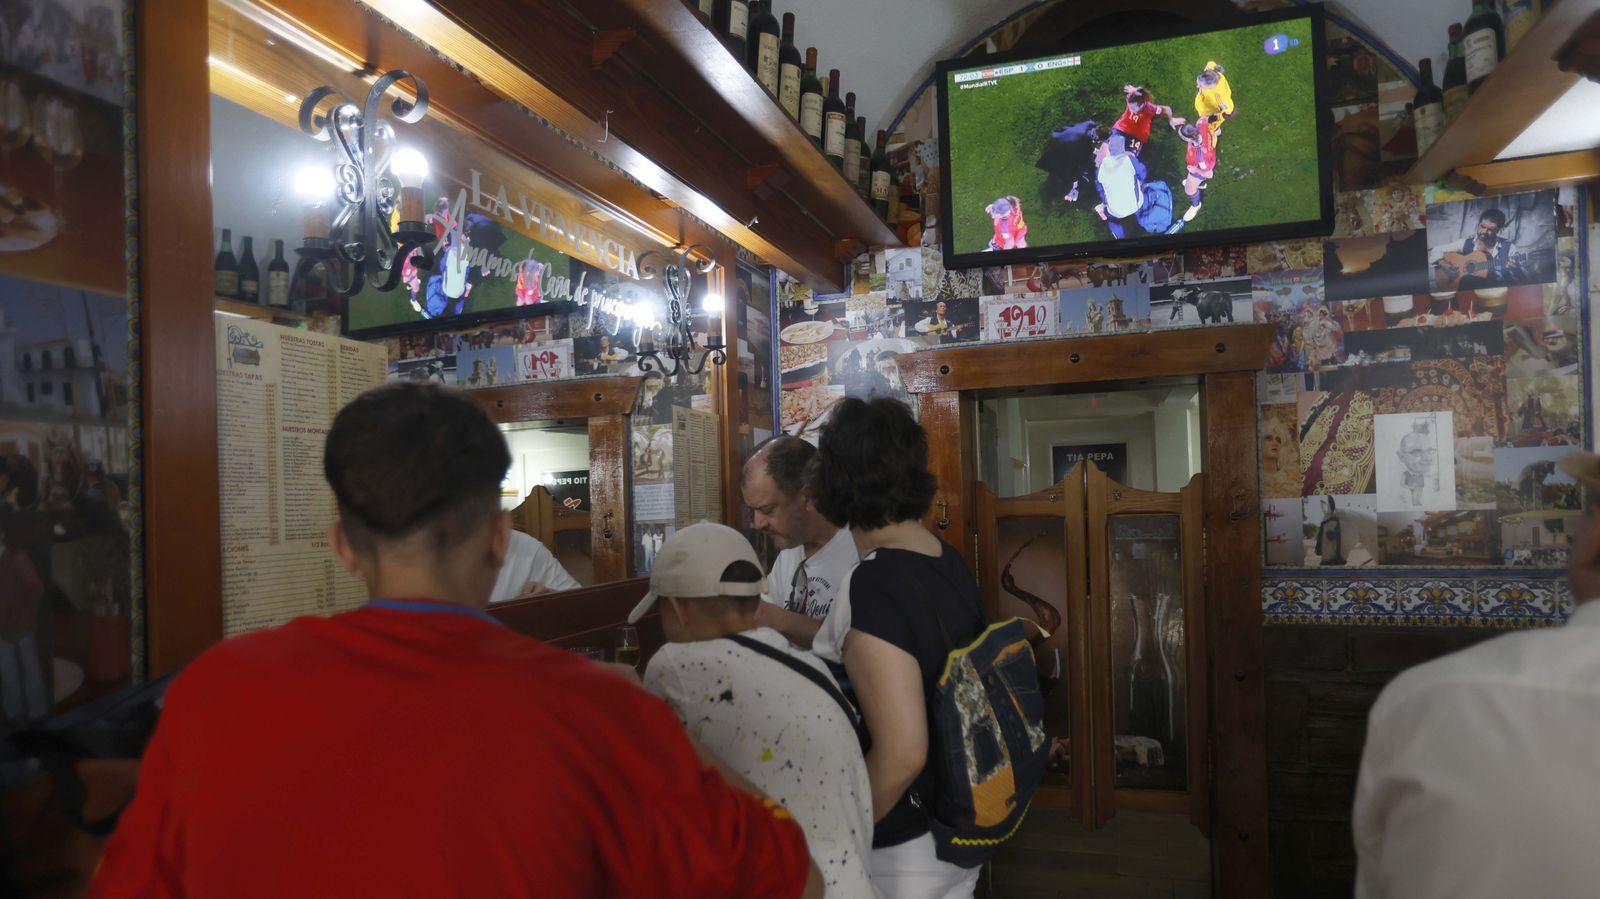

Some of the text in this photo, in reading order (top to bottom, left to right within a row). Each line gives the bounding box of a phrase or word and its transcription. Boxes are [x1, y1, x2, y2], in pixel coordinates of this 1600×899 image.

[999, 68, 1014, 76] ESP
[1047, 60, 1063, 68] ENG
[469, 168, 640, 281] LA VENENCIA
[573, 271, 589, 306] de
[998, 304, 1047, 338] 1912
[1066, 452, 1114, 462] TIA PEPA
